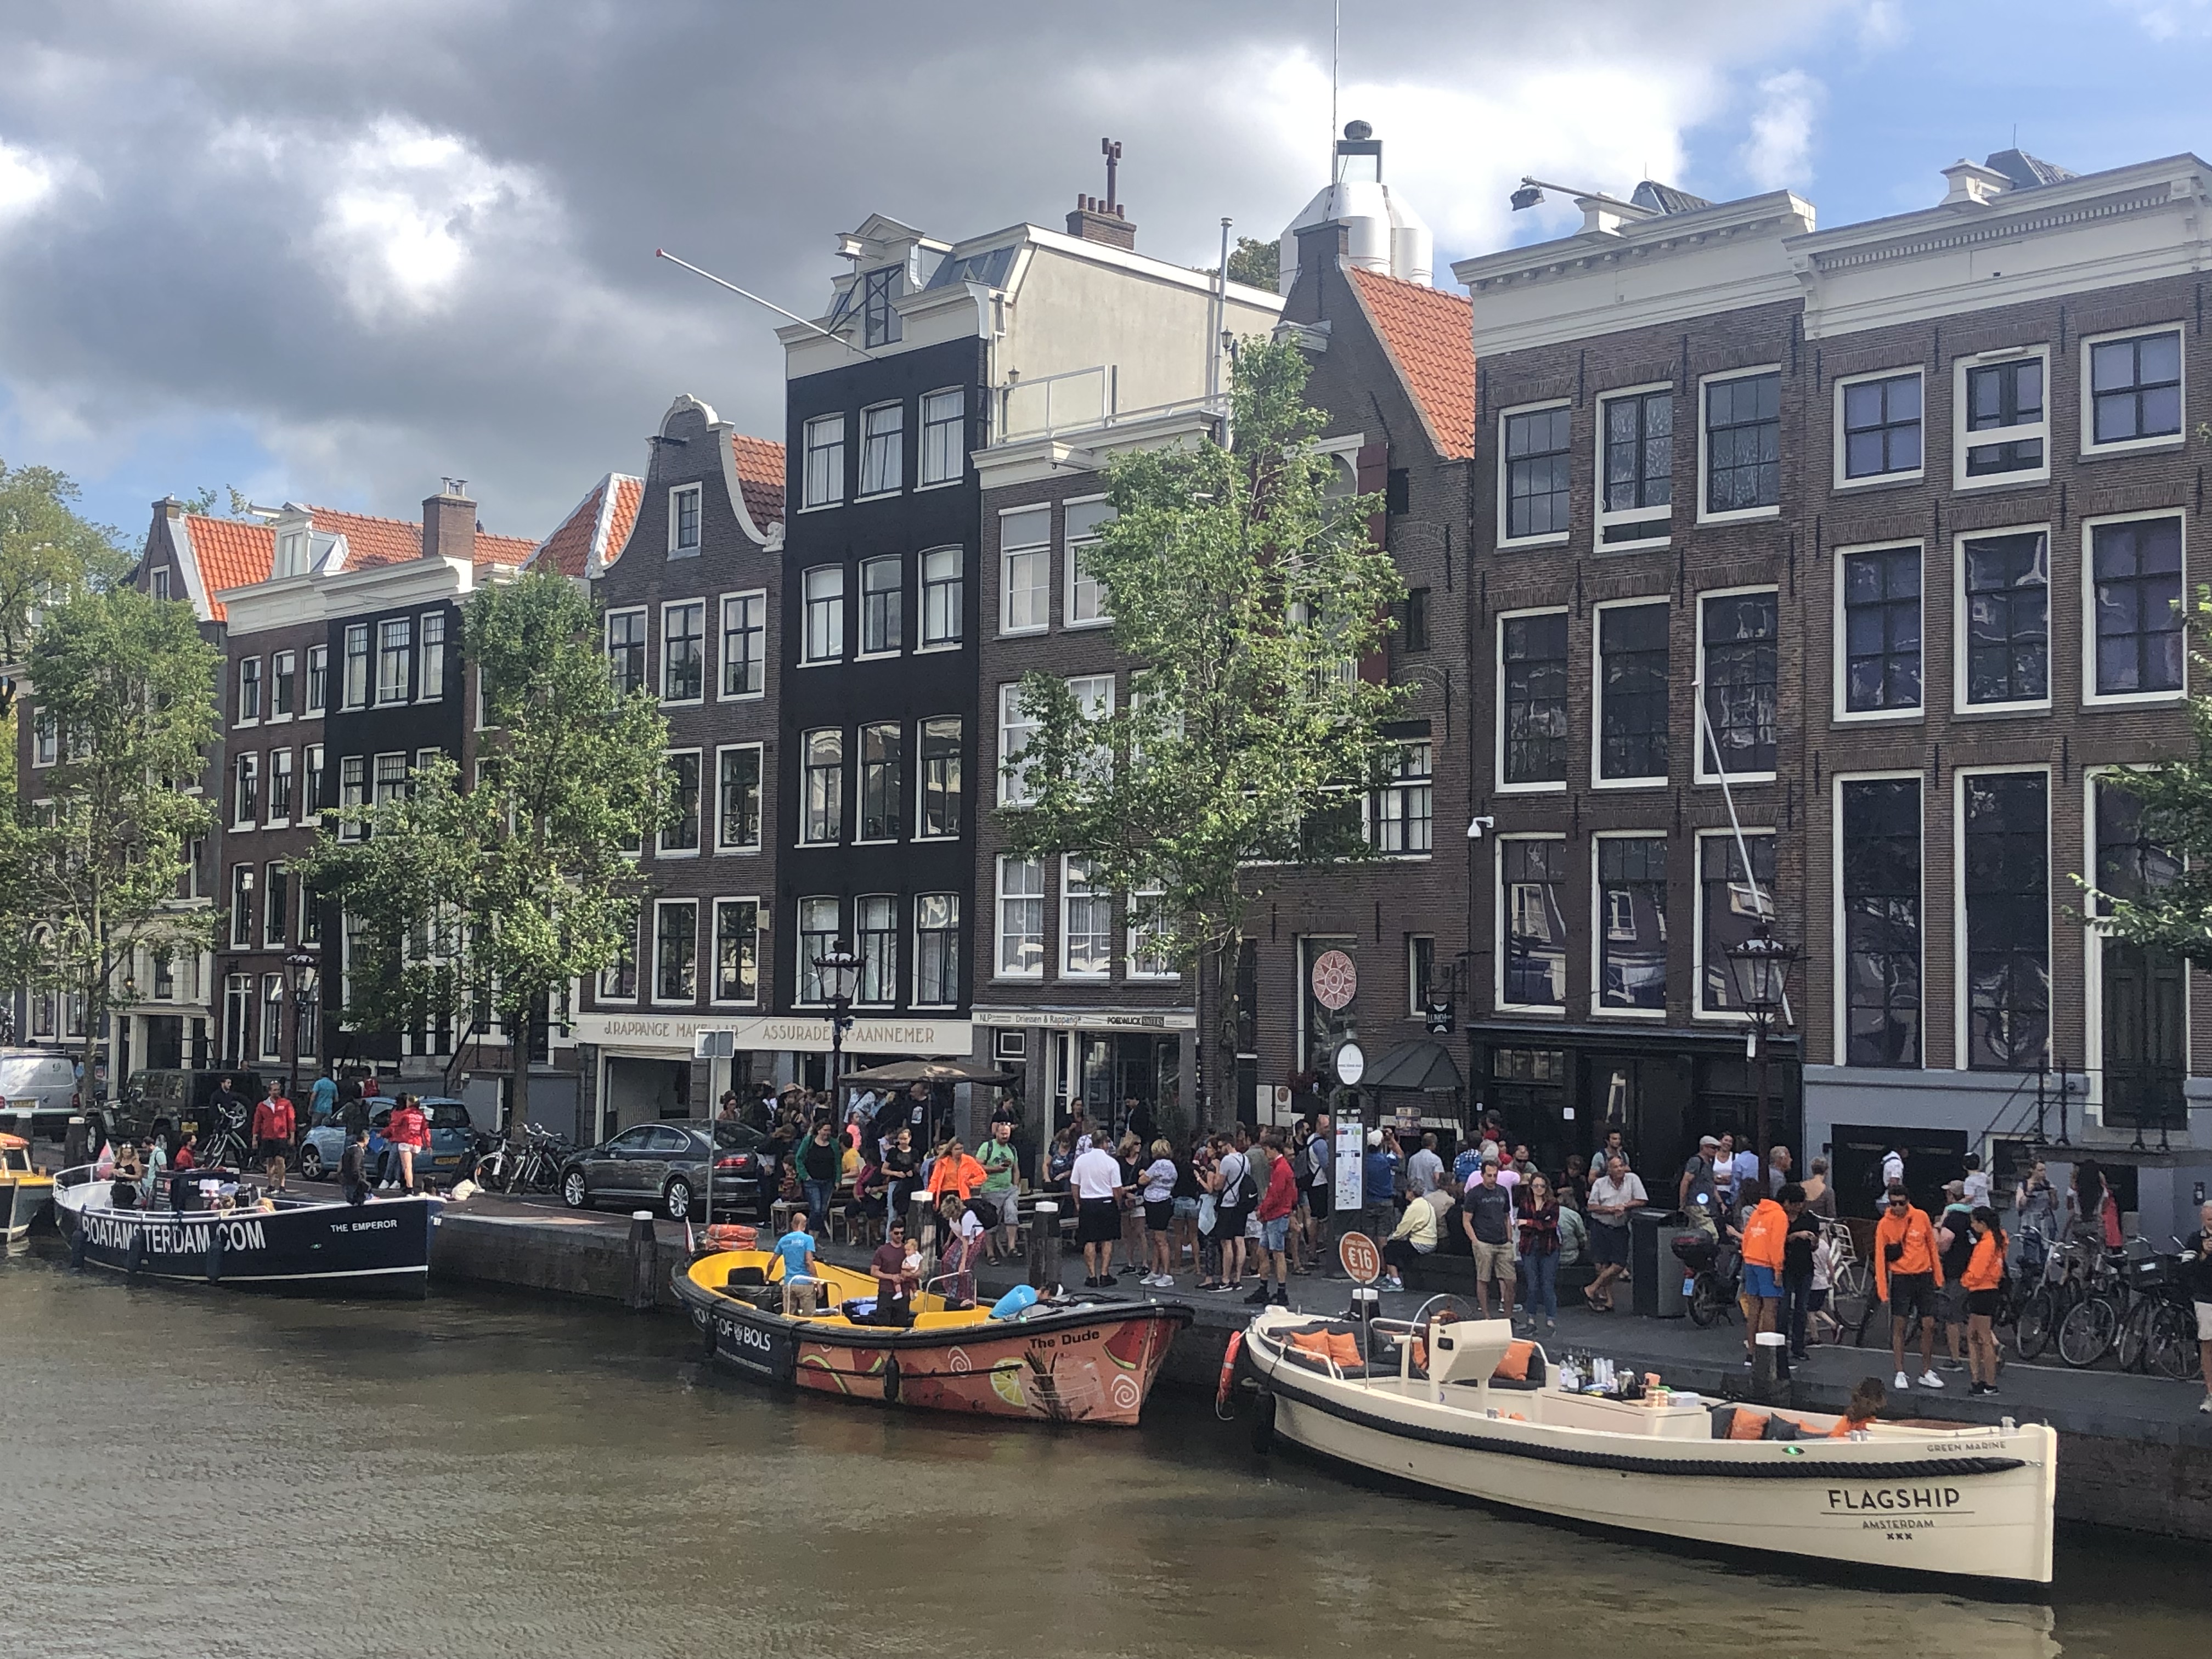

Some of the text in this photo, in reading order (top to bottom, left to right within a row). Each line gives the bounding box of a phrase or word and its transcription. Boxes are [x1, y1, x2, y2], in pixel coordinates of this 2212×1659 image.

[763, 1025, 849, 1041] ASSURADER
[856, 1027, 934, 1043] AANNEMER
[330, 1219, 397, 1232] THE EMPEROR
[1348, 1246, 1373, 1270] €16
[719, 1318, 733, 1337] OF
[744, 1326, 771, 1352] BOLS
[1030, 1330, 1100, 1348] The Dude
[1927, 1441, 2006, 1452] GREEN MARINE
[1827, 1488, 1960, 1509] FLAGSHIP
[1863, 1520, 1934, 1530] AMSTERDAM
